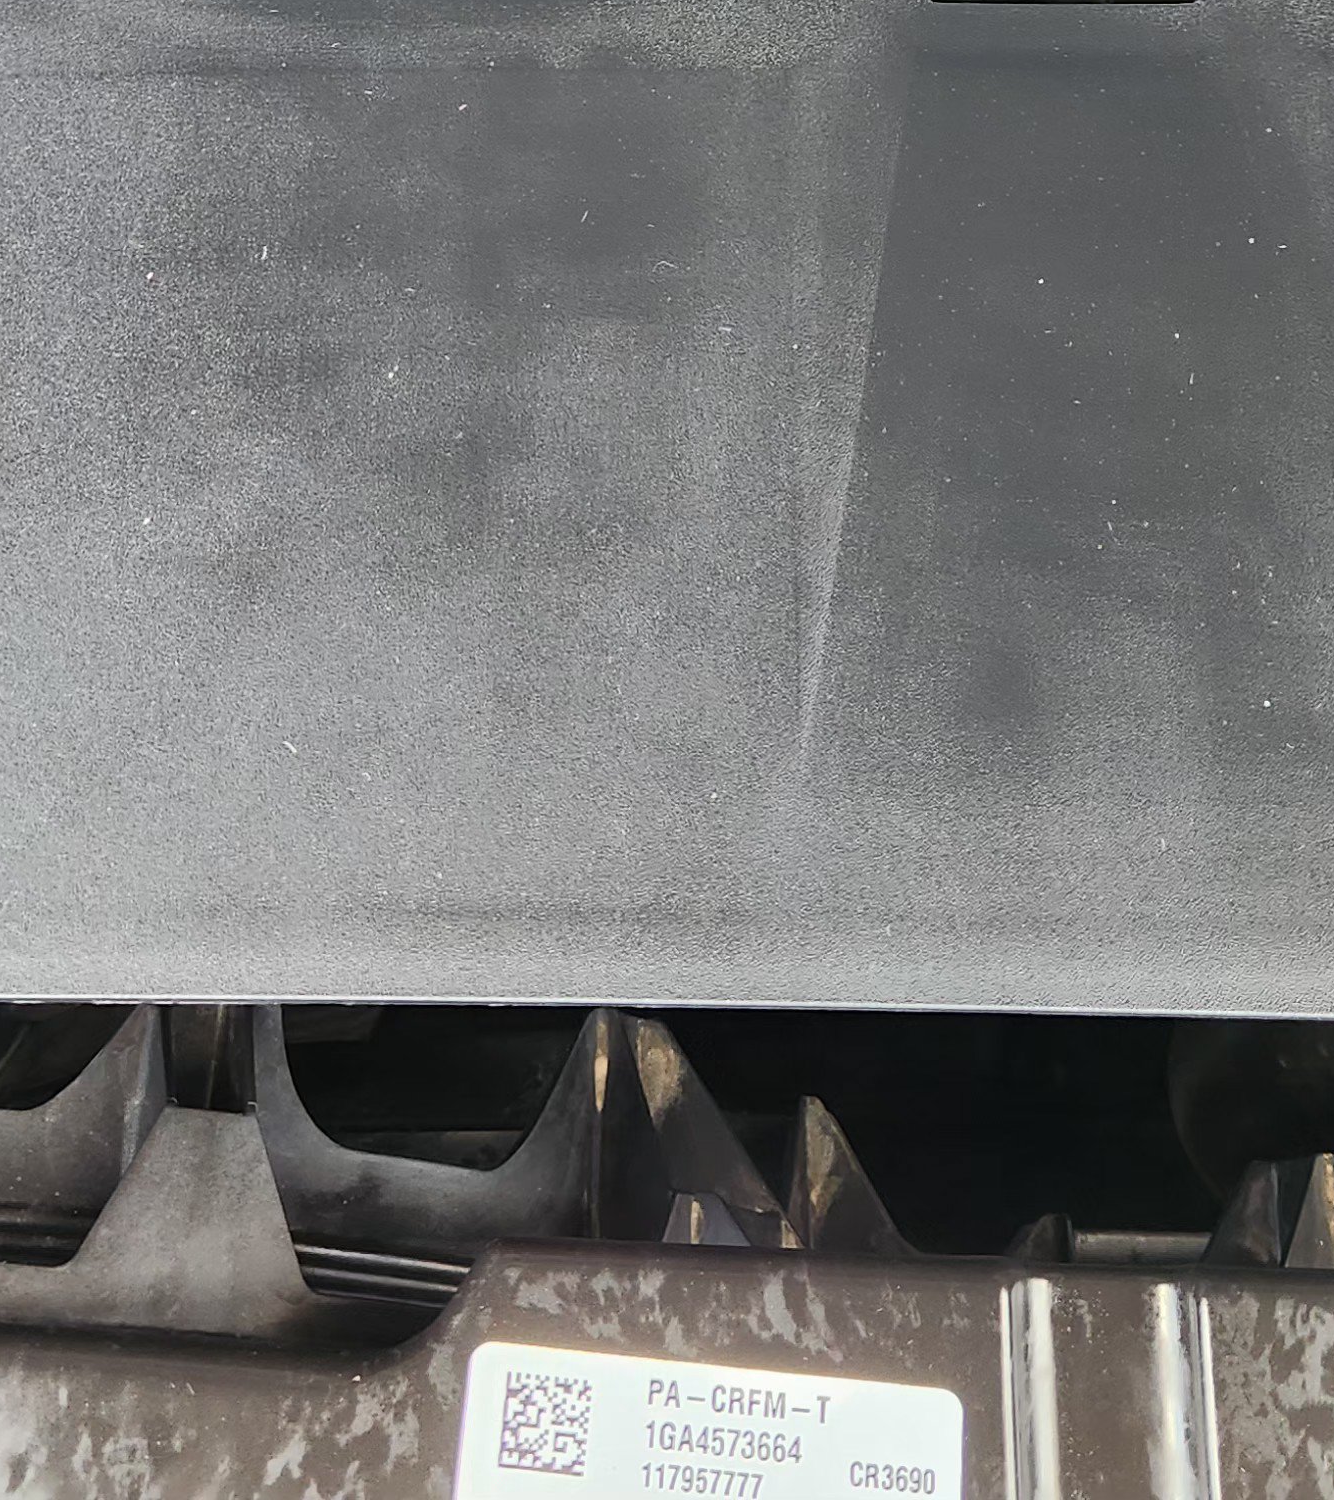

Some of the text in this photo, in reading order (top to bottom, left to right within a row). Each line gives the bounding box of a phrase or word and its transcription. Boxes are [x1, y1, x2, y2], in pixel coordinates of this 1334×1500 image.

[646, 1420, 803, 1464] 1GA4573664
[641, 1460, 936, 1500] 117957777 CR3690
